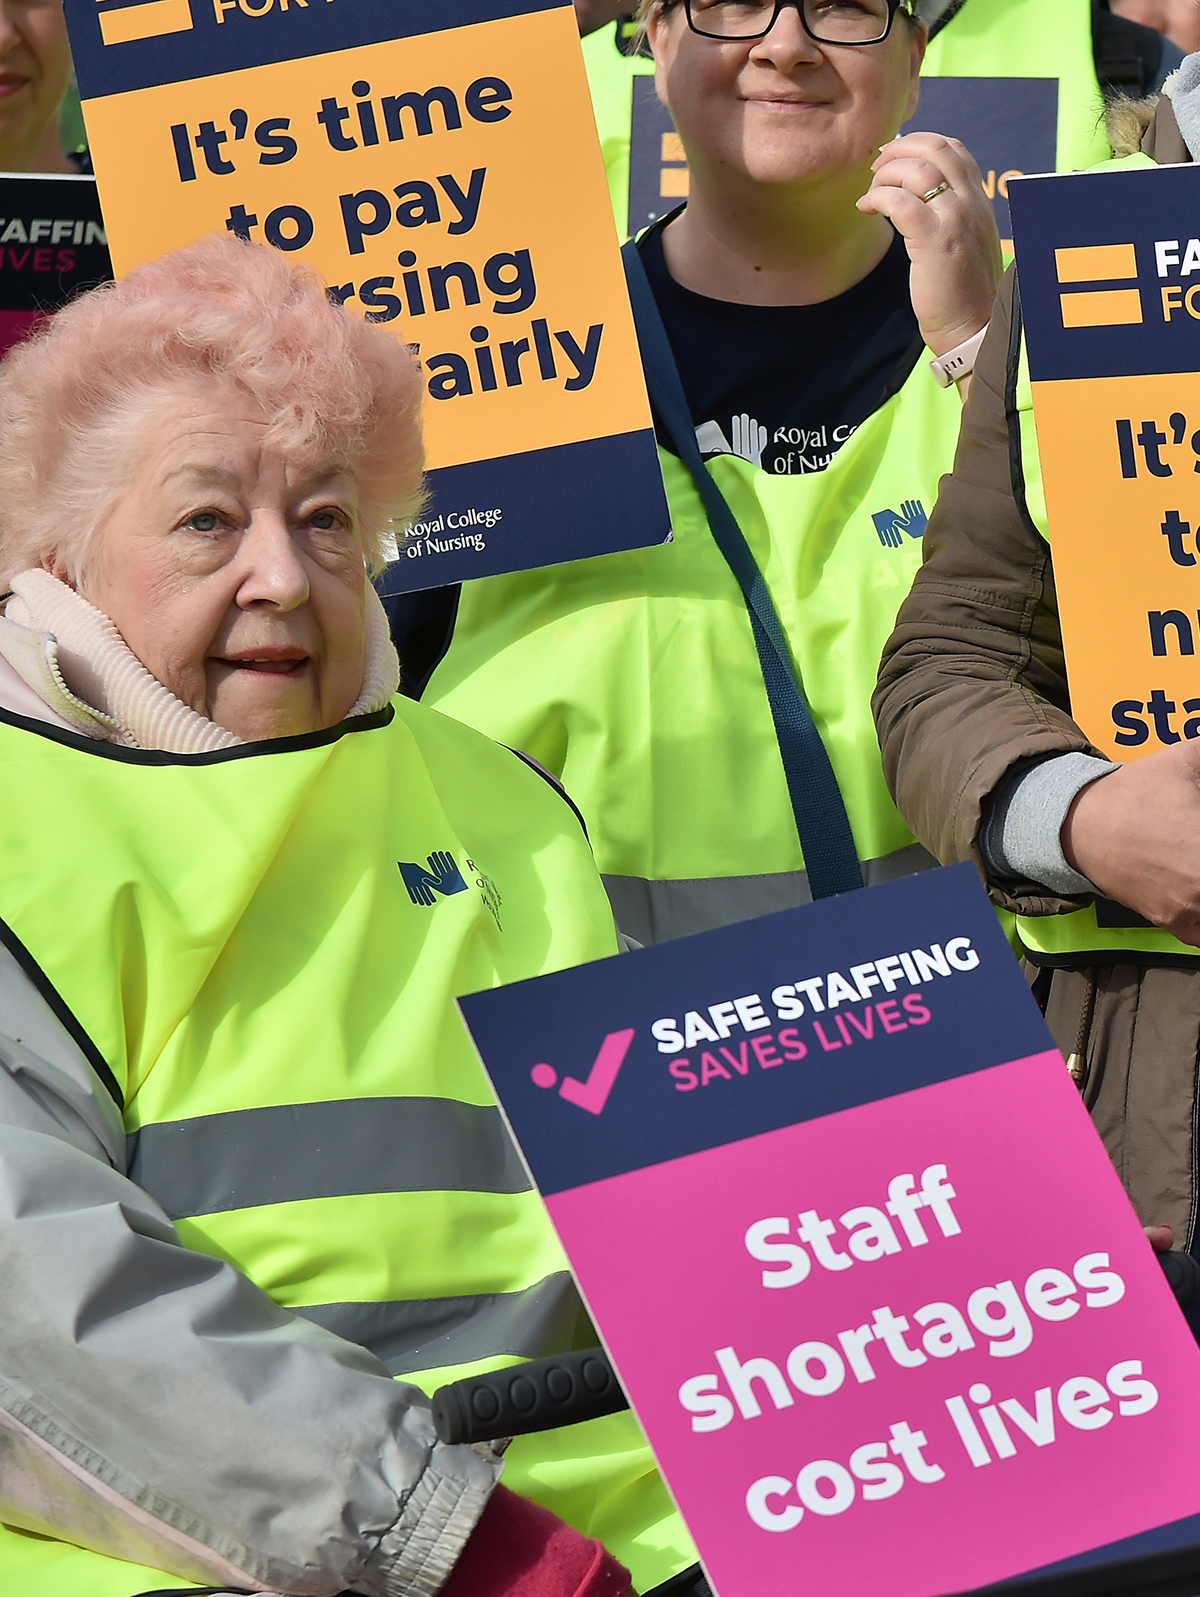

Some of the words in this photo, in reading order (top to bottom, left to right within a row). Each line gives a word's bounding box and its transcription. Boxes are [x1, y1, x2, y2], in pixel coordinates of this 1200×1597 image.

[171, 109, 297, 182] It’s
[318, 77, 512, 151] time
[226, 206, 313, 250] to
[340, 168, 485, 255] pay
[326, 249, 536, 323] rsing
[404, 318, 604, 401] airly
[774, 425, 828, 453] Royal
[774, 452, 795, 474] of
[407, 540, 423, 558] of
[426, 533, 485, 552] Nursing
[446, 508, 502, 528] College
[652, 993, 771, 1053] SAFE
[772, 938, 979, 1020] STAFFING
[670, 1029, 807, 1091] SAVES
[814, 994, 931, 1051] LIVES
[745, 1164, 961, 1288] Staff
[679, 1253, 1125, 1432] shortages
[746, 1422, 945, 1532] cost
[945, 1360, 1158, 1467] lives
